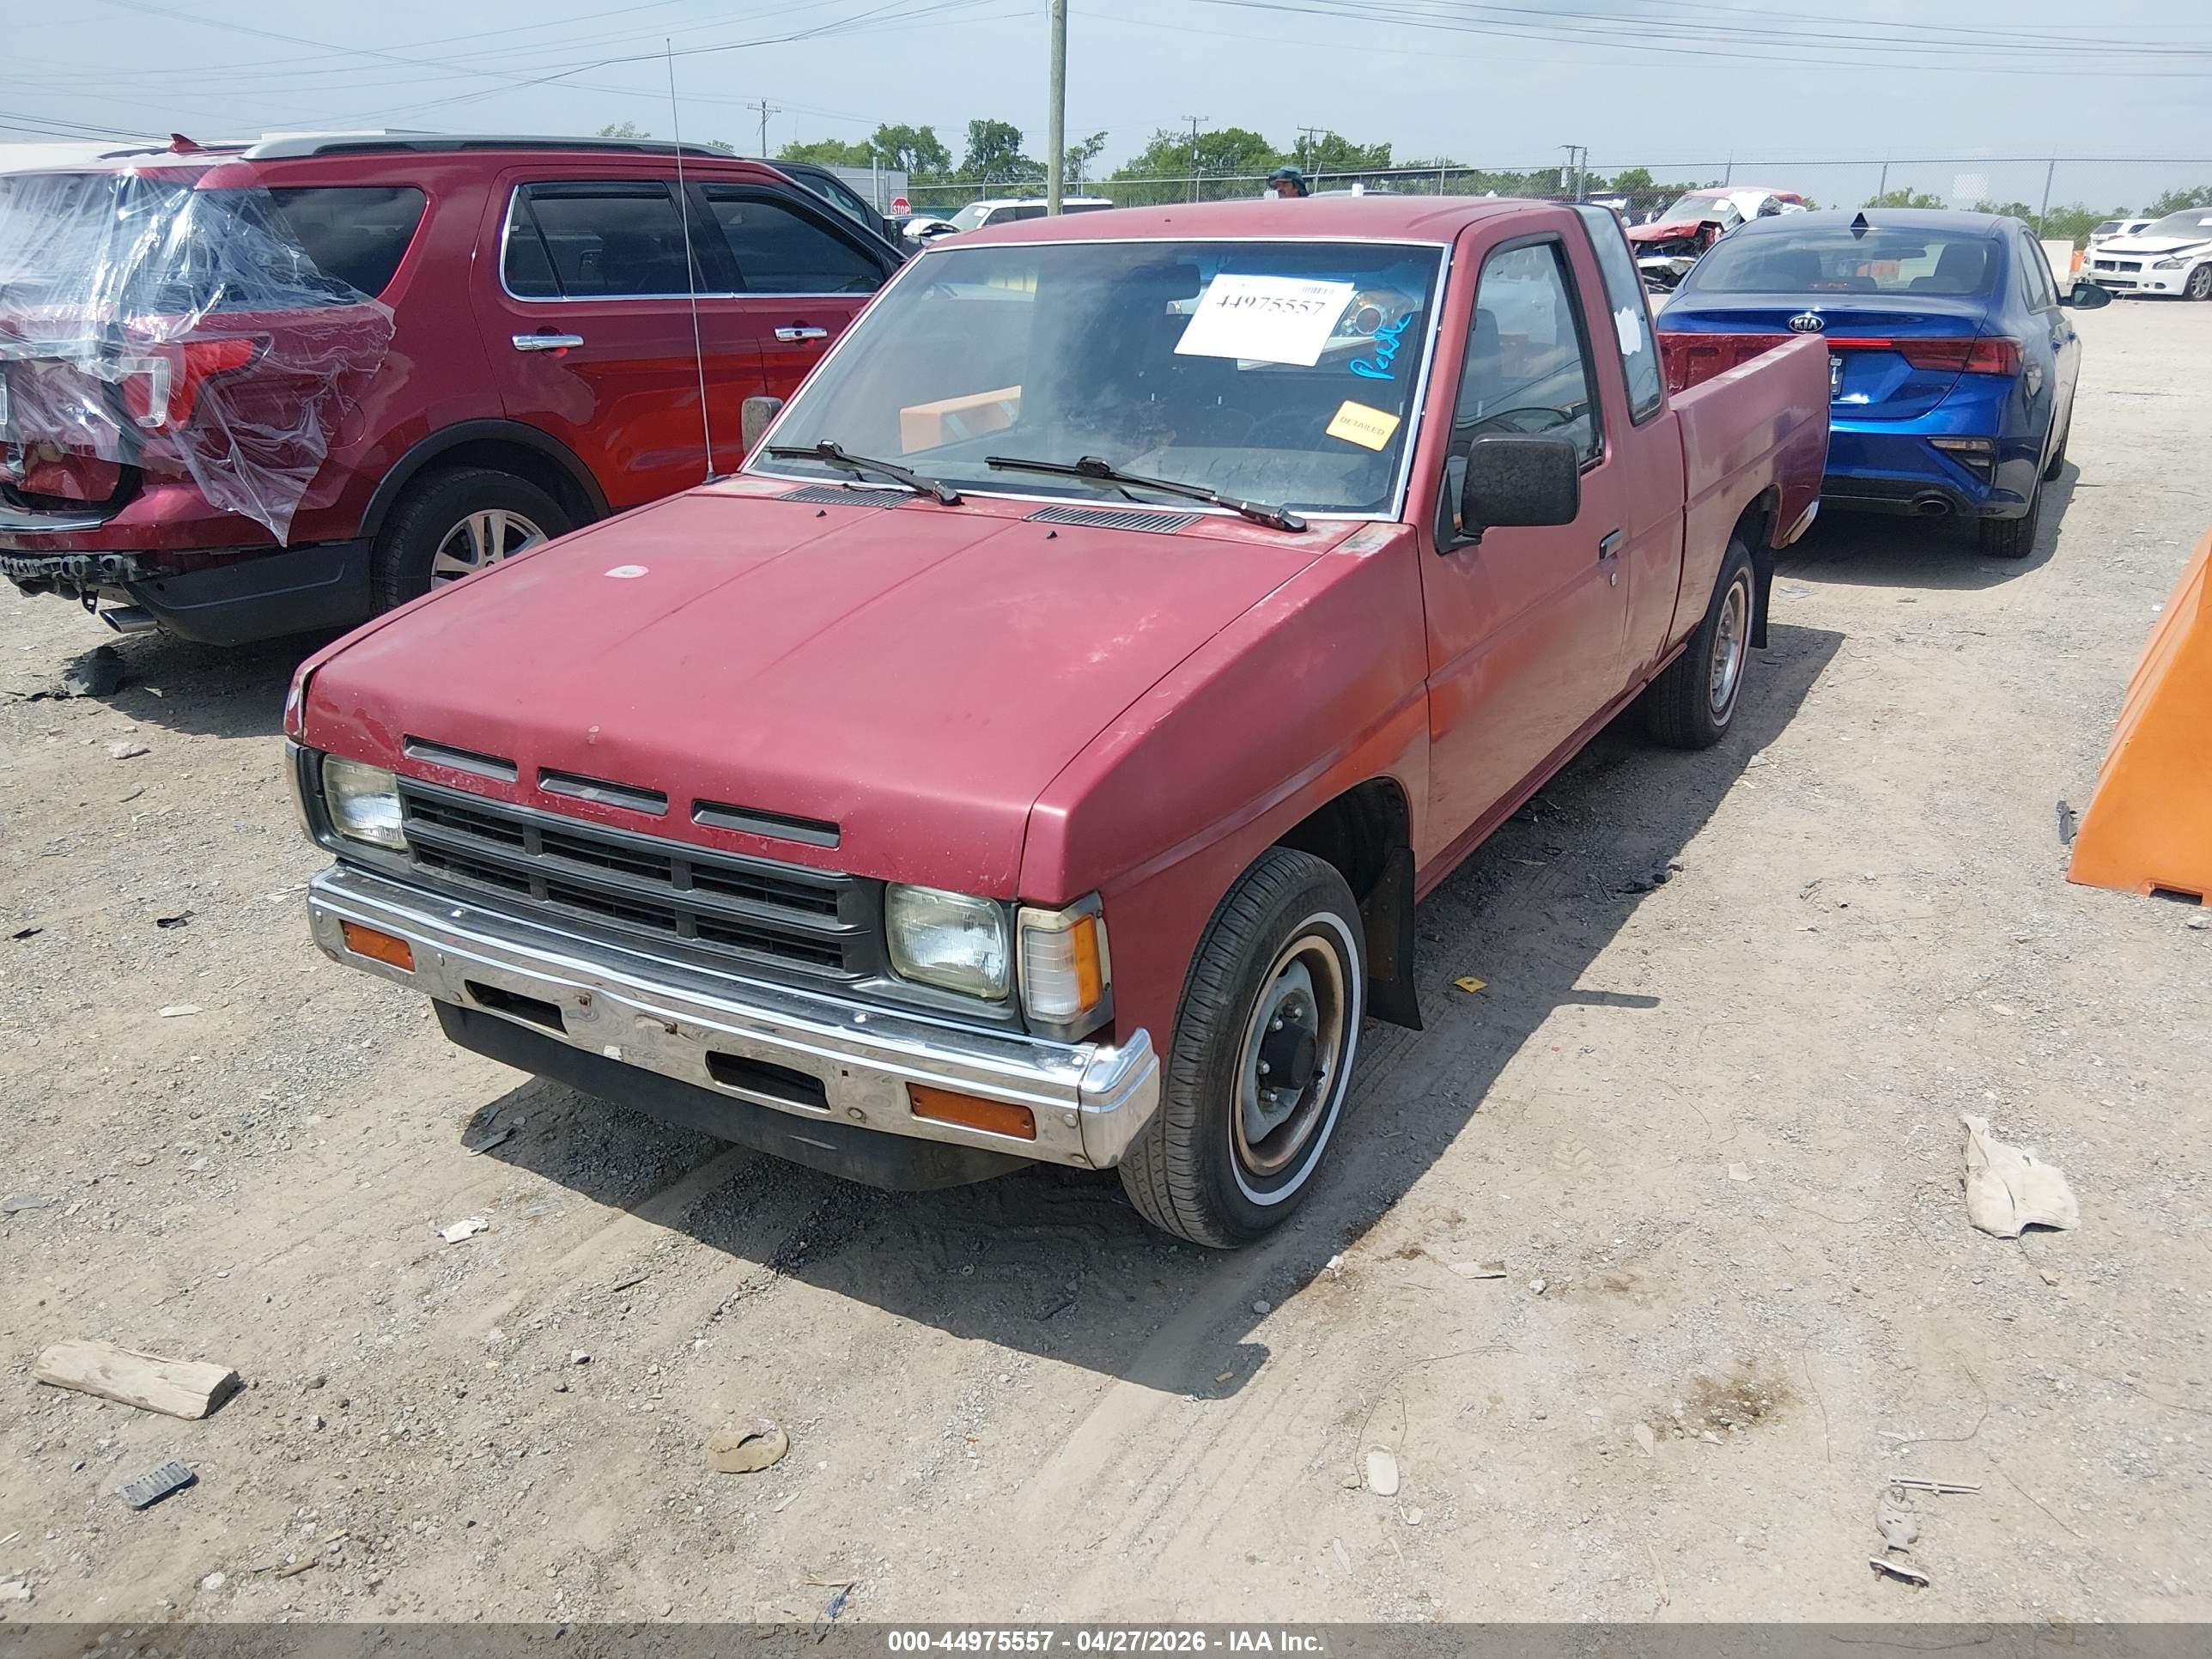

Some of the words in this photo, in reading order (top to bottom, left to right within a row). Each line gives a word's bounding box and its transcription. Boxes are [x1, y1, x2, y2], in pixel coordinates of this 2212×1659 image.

[893, 205, 910, 215] STOP
[1216, 295, 1326, 315] 44975557
[1794, 319, 1818, 330] KIA
[1339, 416, 1385, 436] DETAILED
